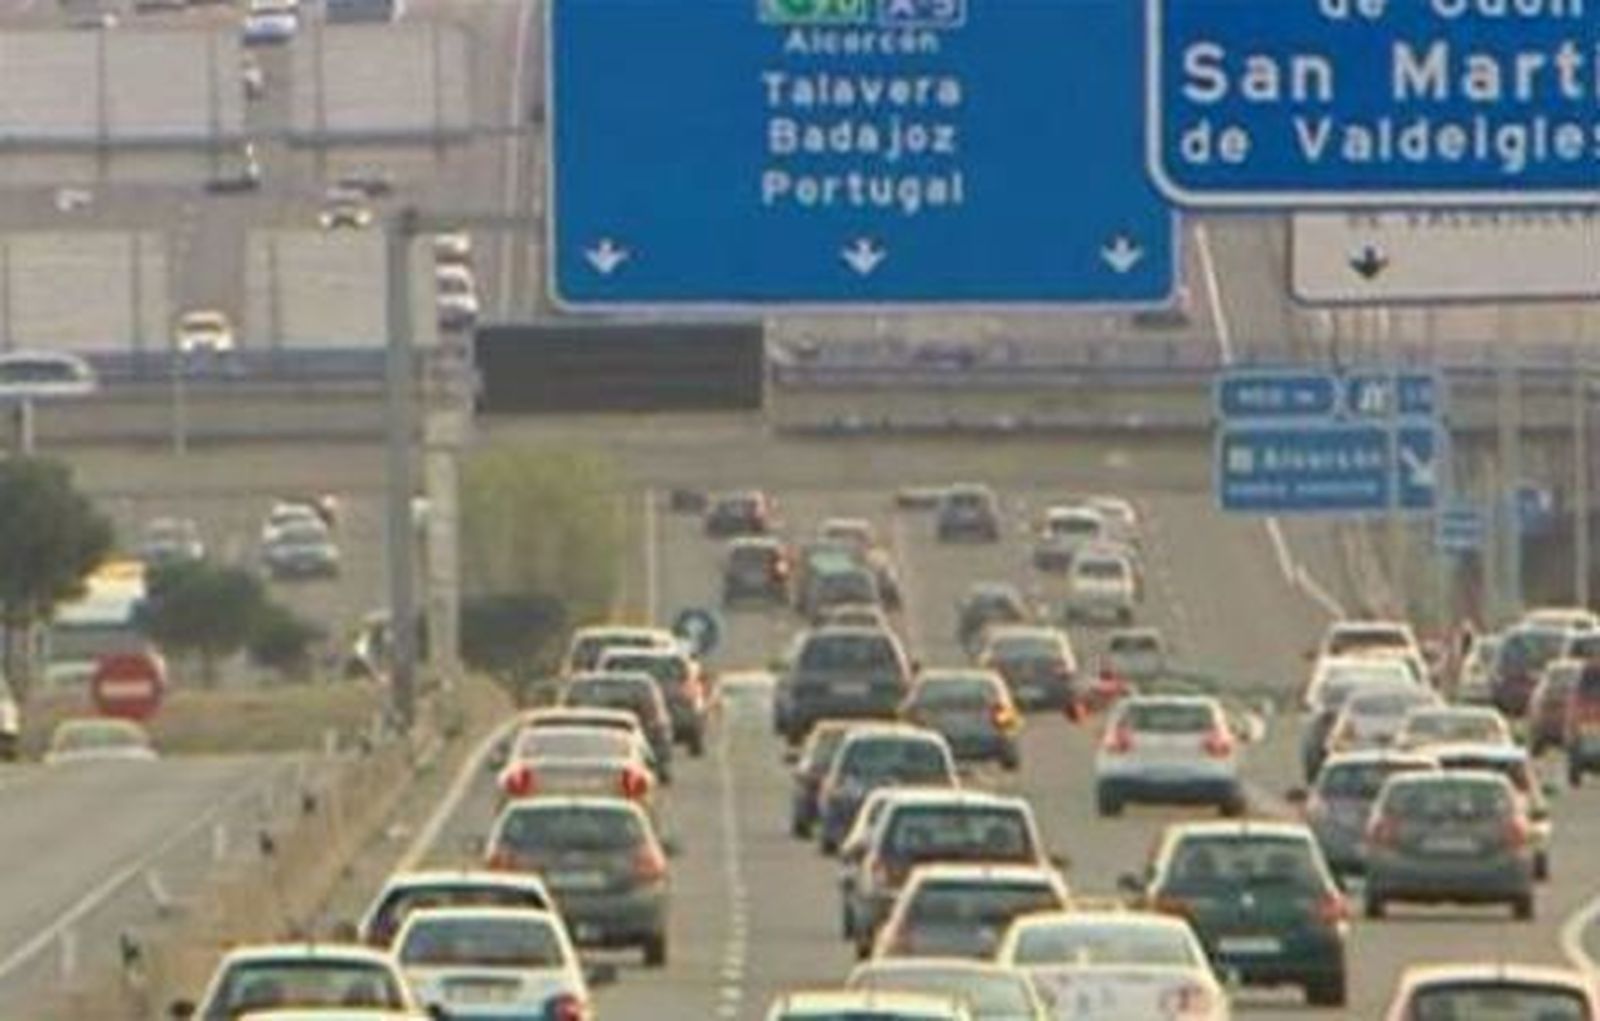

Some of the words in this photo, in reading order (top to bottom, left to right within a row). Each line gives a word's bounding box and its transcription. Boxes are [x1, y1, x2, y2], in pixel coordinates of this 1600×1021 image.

[762, 71, 960, 106] Talavera
[1183, 42, 1333, 102] San
[769, 117, 955, 162] Badajoz
[1181, 117, 1251, 163] de
[762, 170, 964, 214] Portugal
